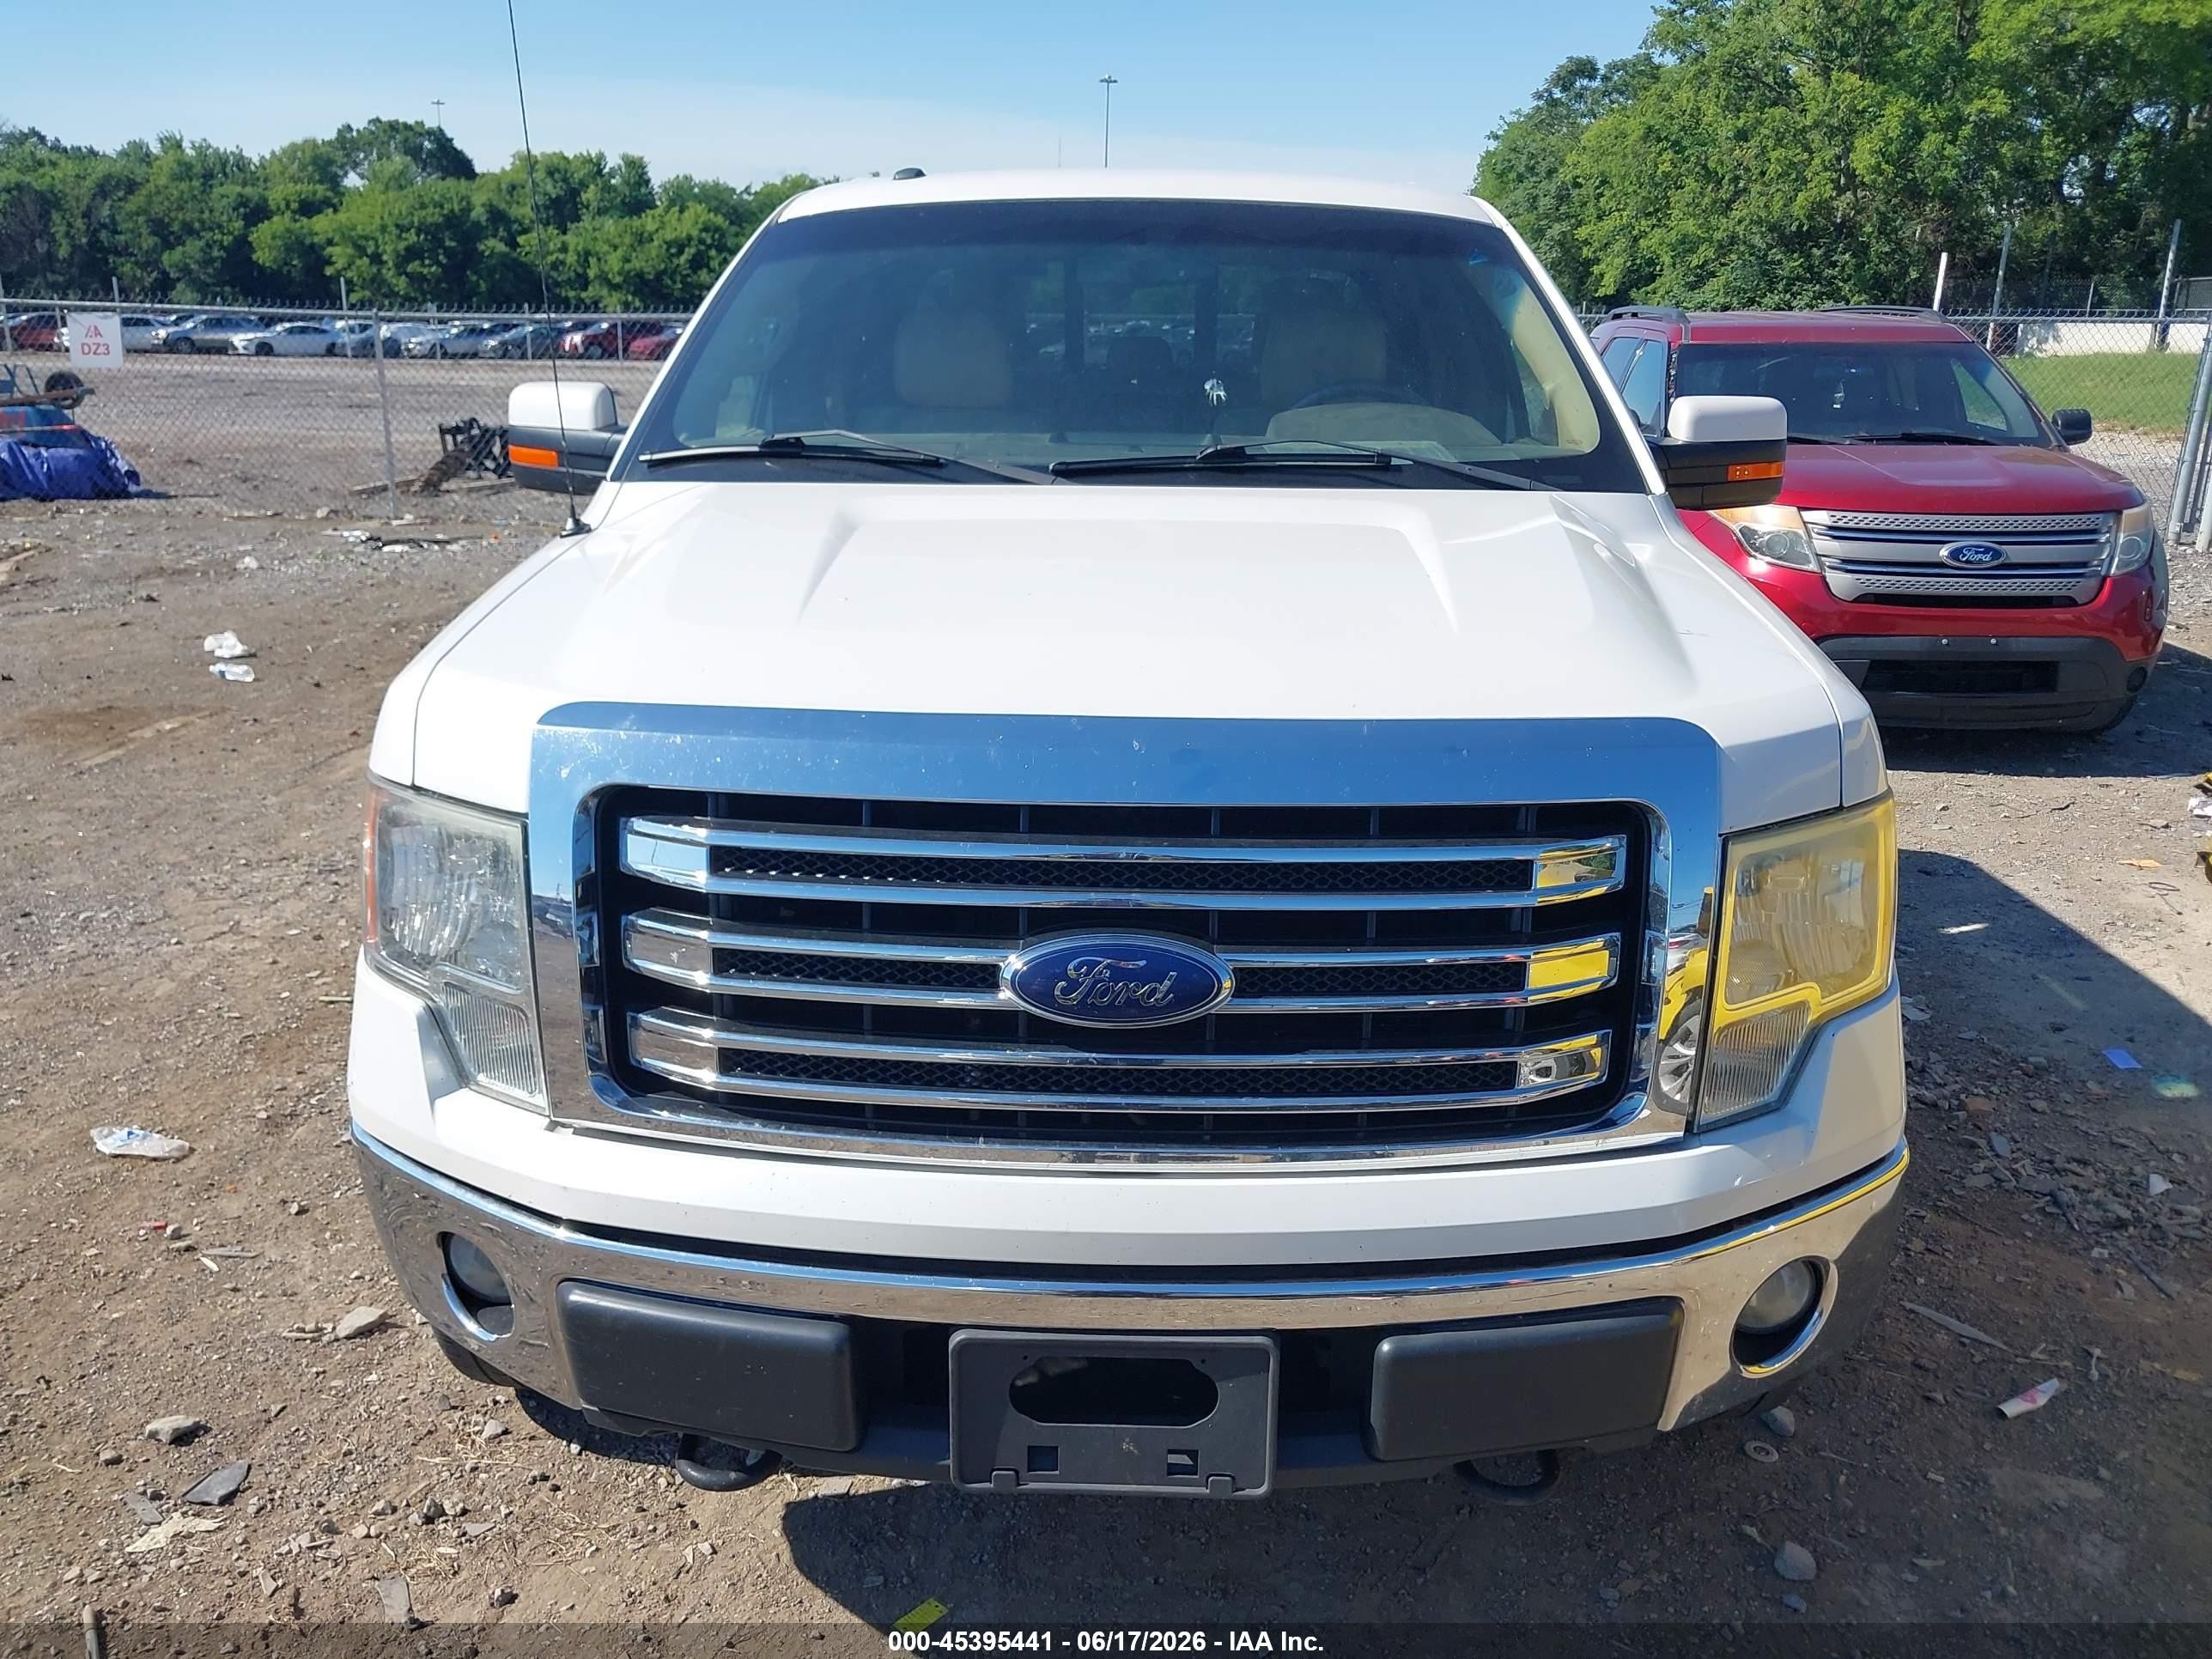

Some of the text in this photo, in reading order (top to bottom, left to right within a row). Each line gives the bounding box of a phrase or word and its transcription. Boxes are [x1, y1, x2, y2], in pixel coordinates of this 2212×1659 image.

[81, 343, 111, 356] DZ3
[1959, 547, 1993, 562] Ford
[1054, 957, 1176, 1006] Ford
